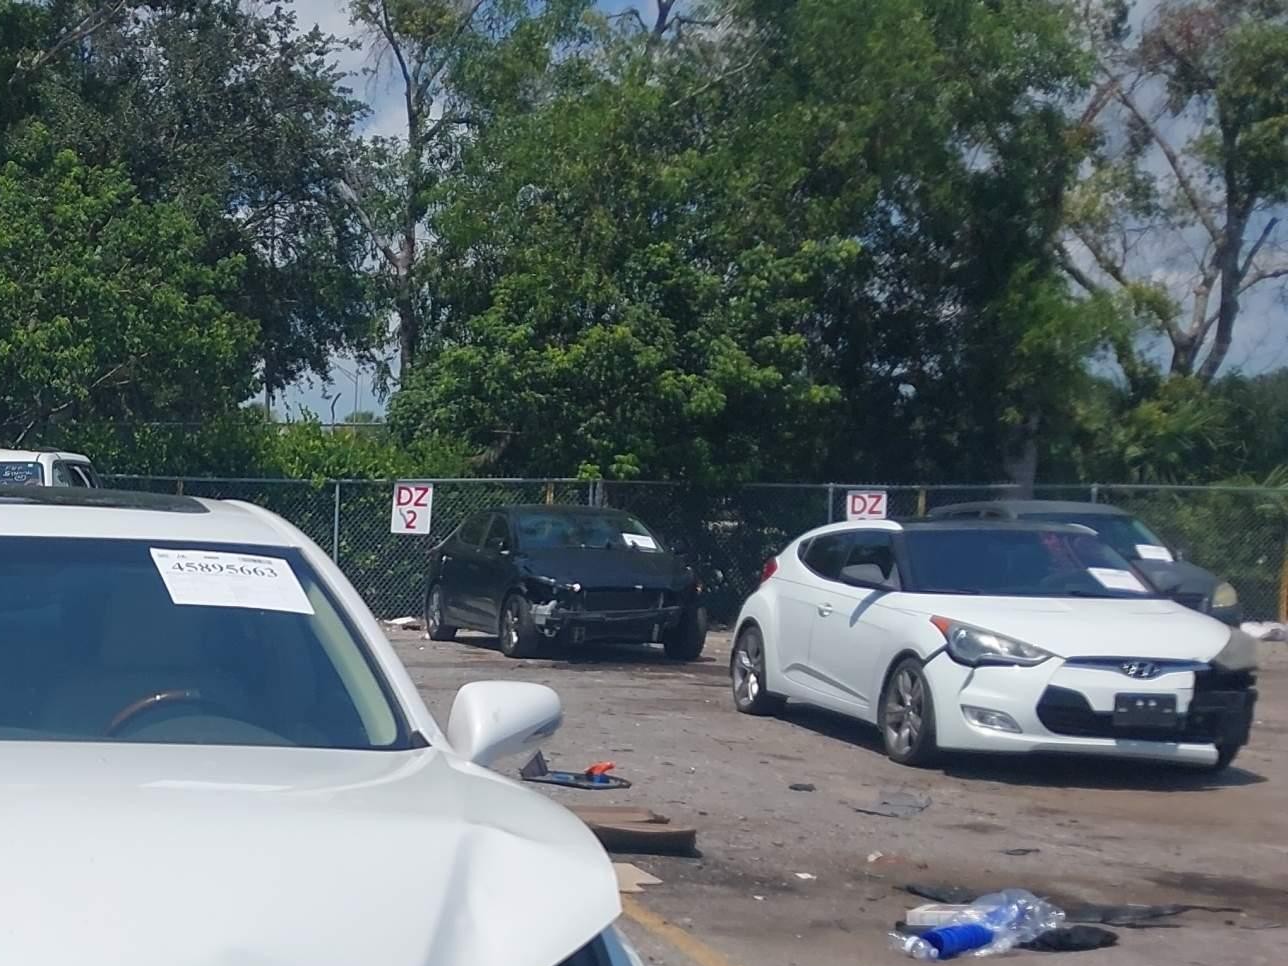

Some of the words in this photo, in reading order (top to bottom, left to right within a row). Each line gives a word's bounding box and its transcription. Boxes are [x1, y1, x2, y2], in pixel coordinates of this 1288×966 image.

[397, 486, 428, 507] DZ
[851, 495, 882, 514] DZ
[405, 510, 417, 529] 2
[172, 561, 278, 578] 45895663
